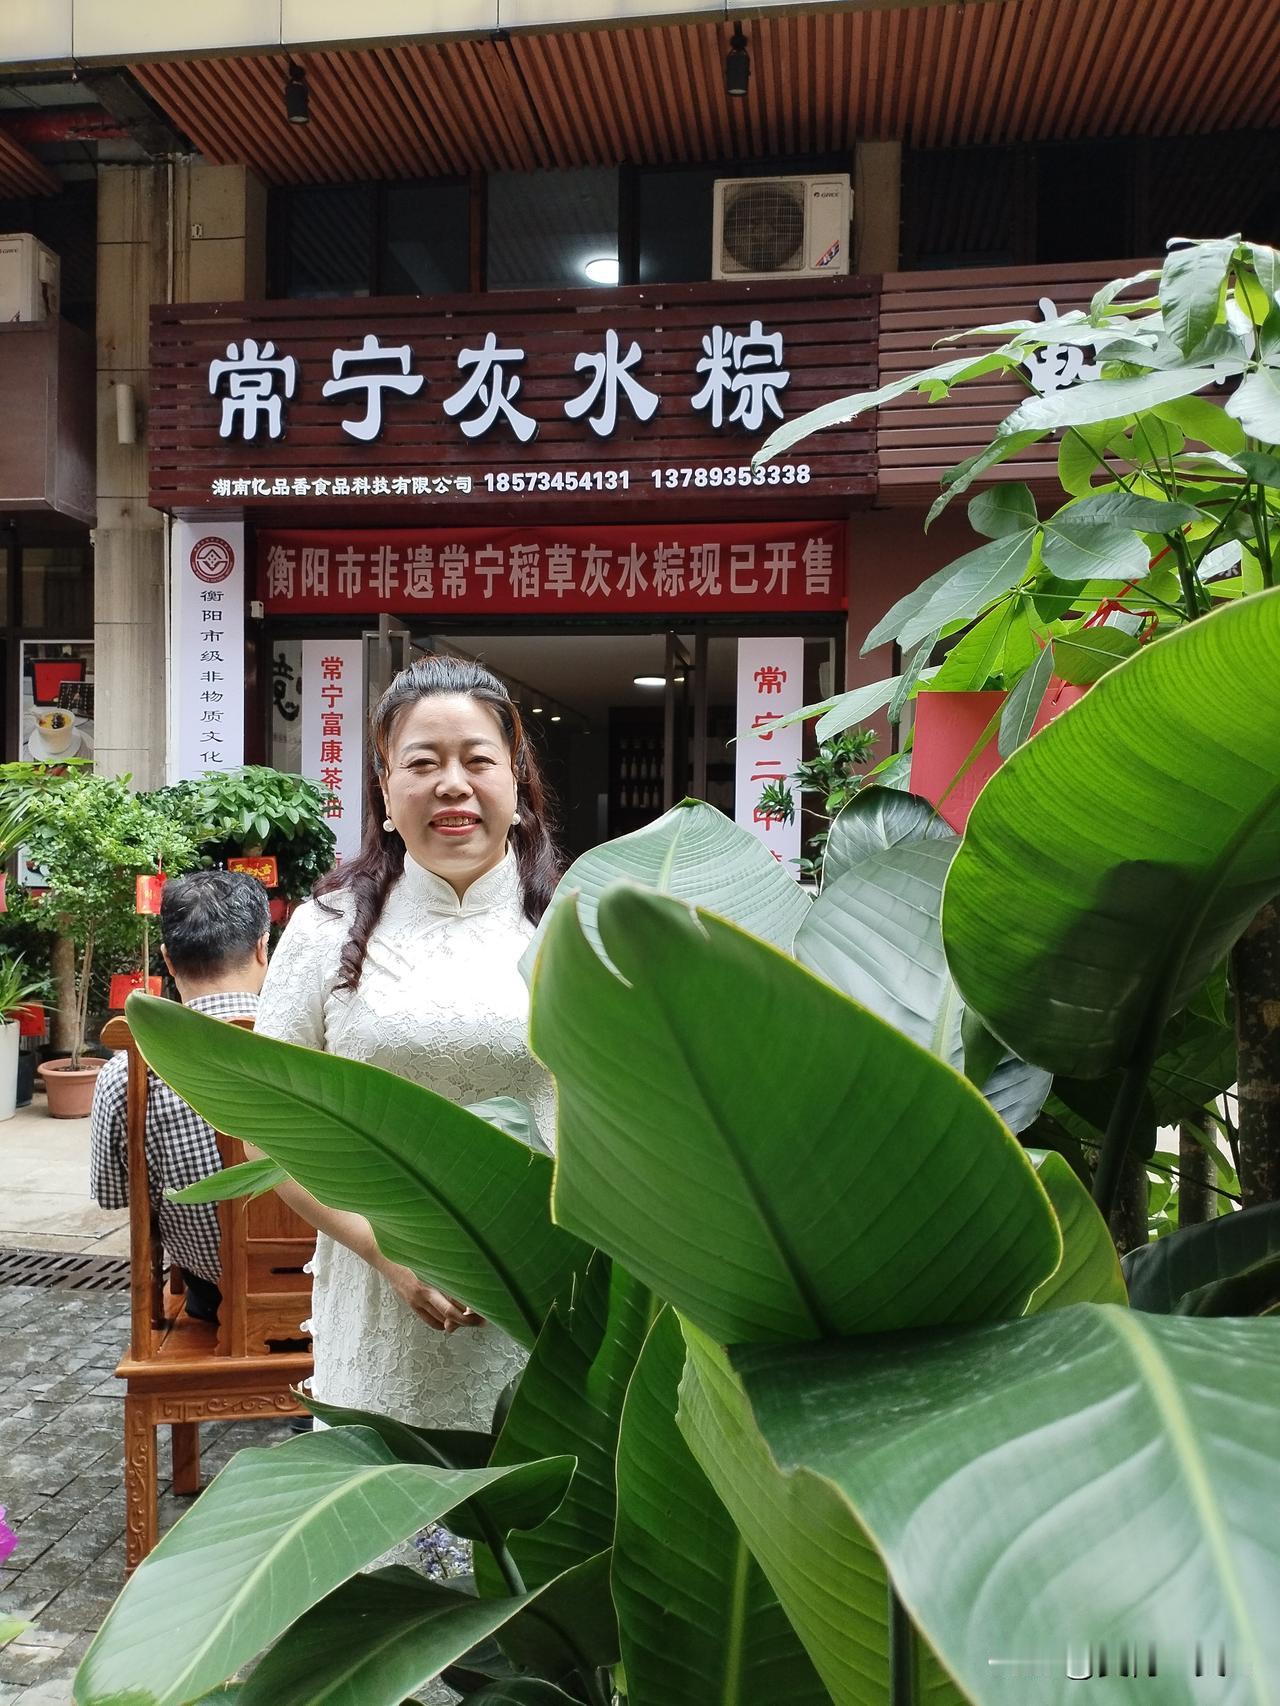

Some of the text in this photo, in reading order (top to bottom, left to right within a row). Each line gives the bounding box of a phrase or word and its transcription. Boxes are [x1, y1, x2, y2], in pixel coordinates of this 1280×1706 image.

[208, 320, 791, 442] 常宁灰水粽
[484, 470, 629, 492] 18573454131
[651, 464, 811, 489] 13789353338
[266, 538, 834, 599] 衡阳市非遗常宁稻草灰水粽现已开售
[200, 590, 224, 763] 衡阳市级非物质文化
[750, 666, 788, 863] 常宁二中
